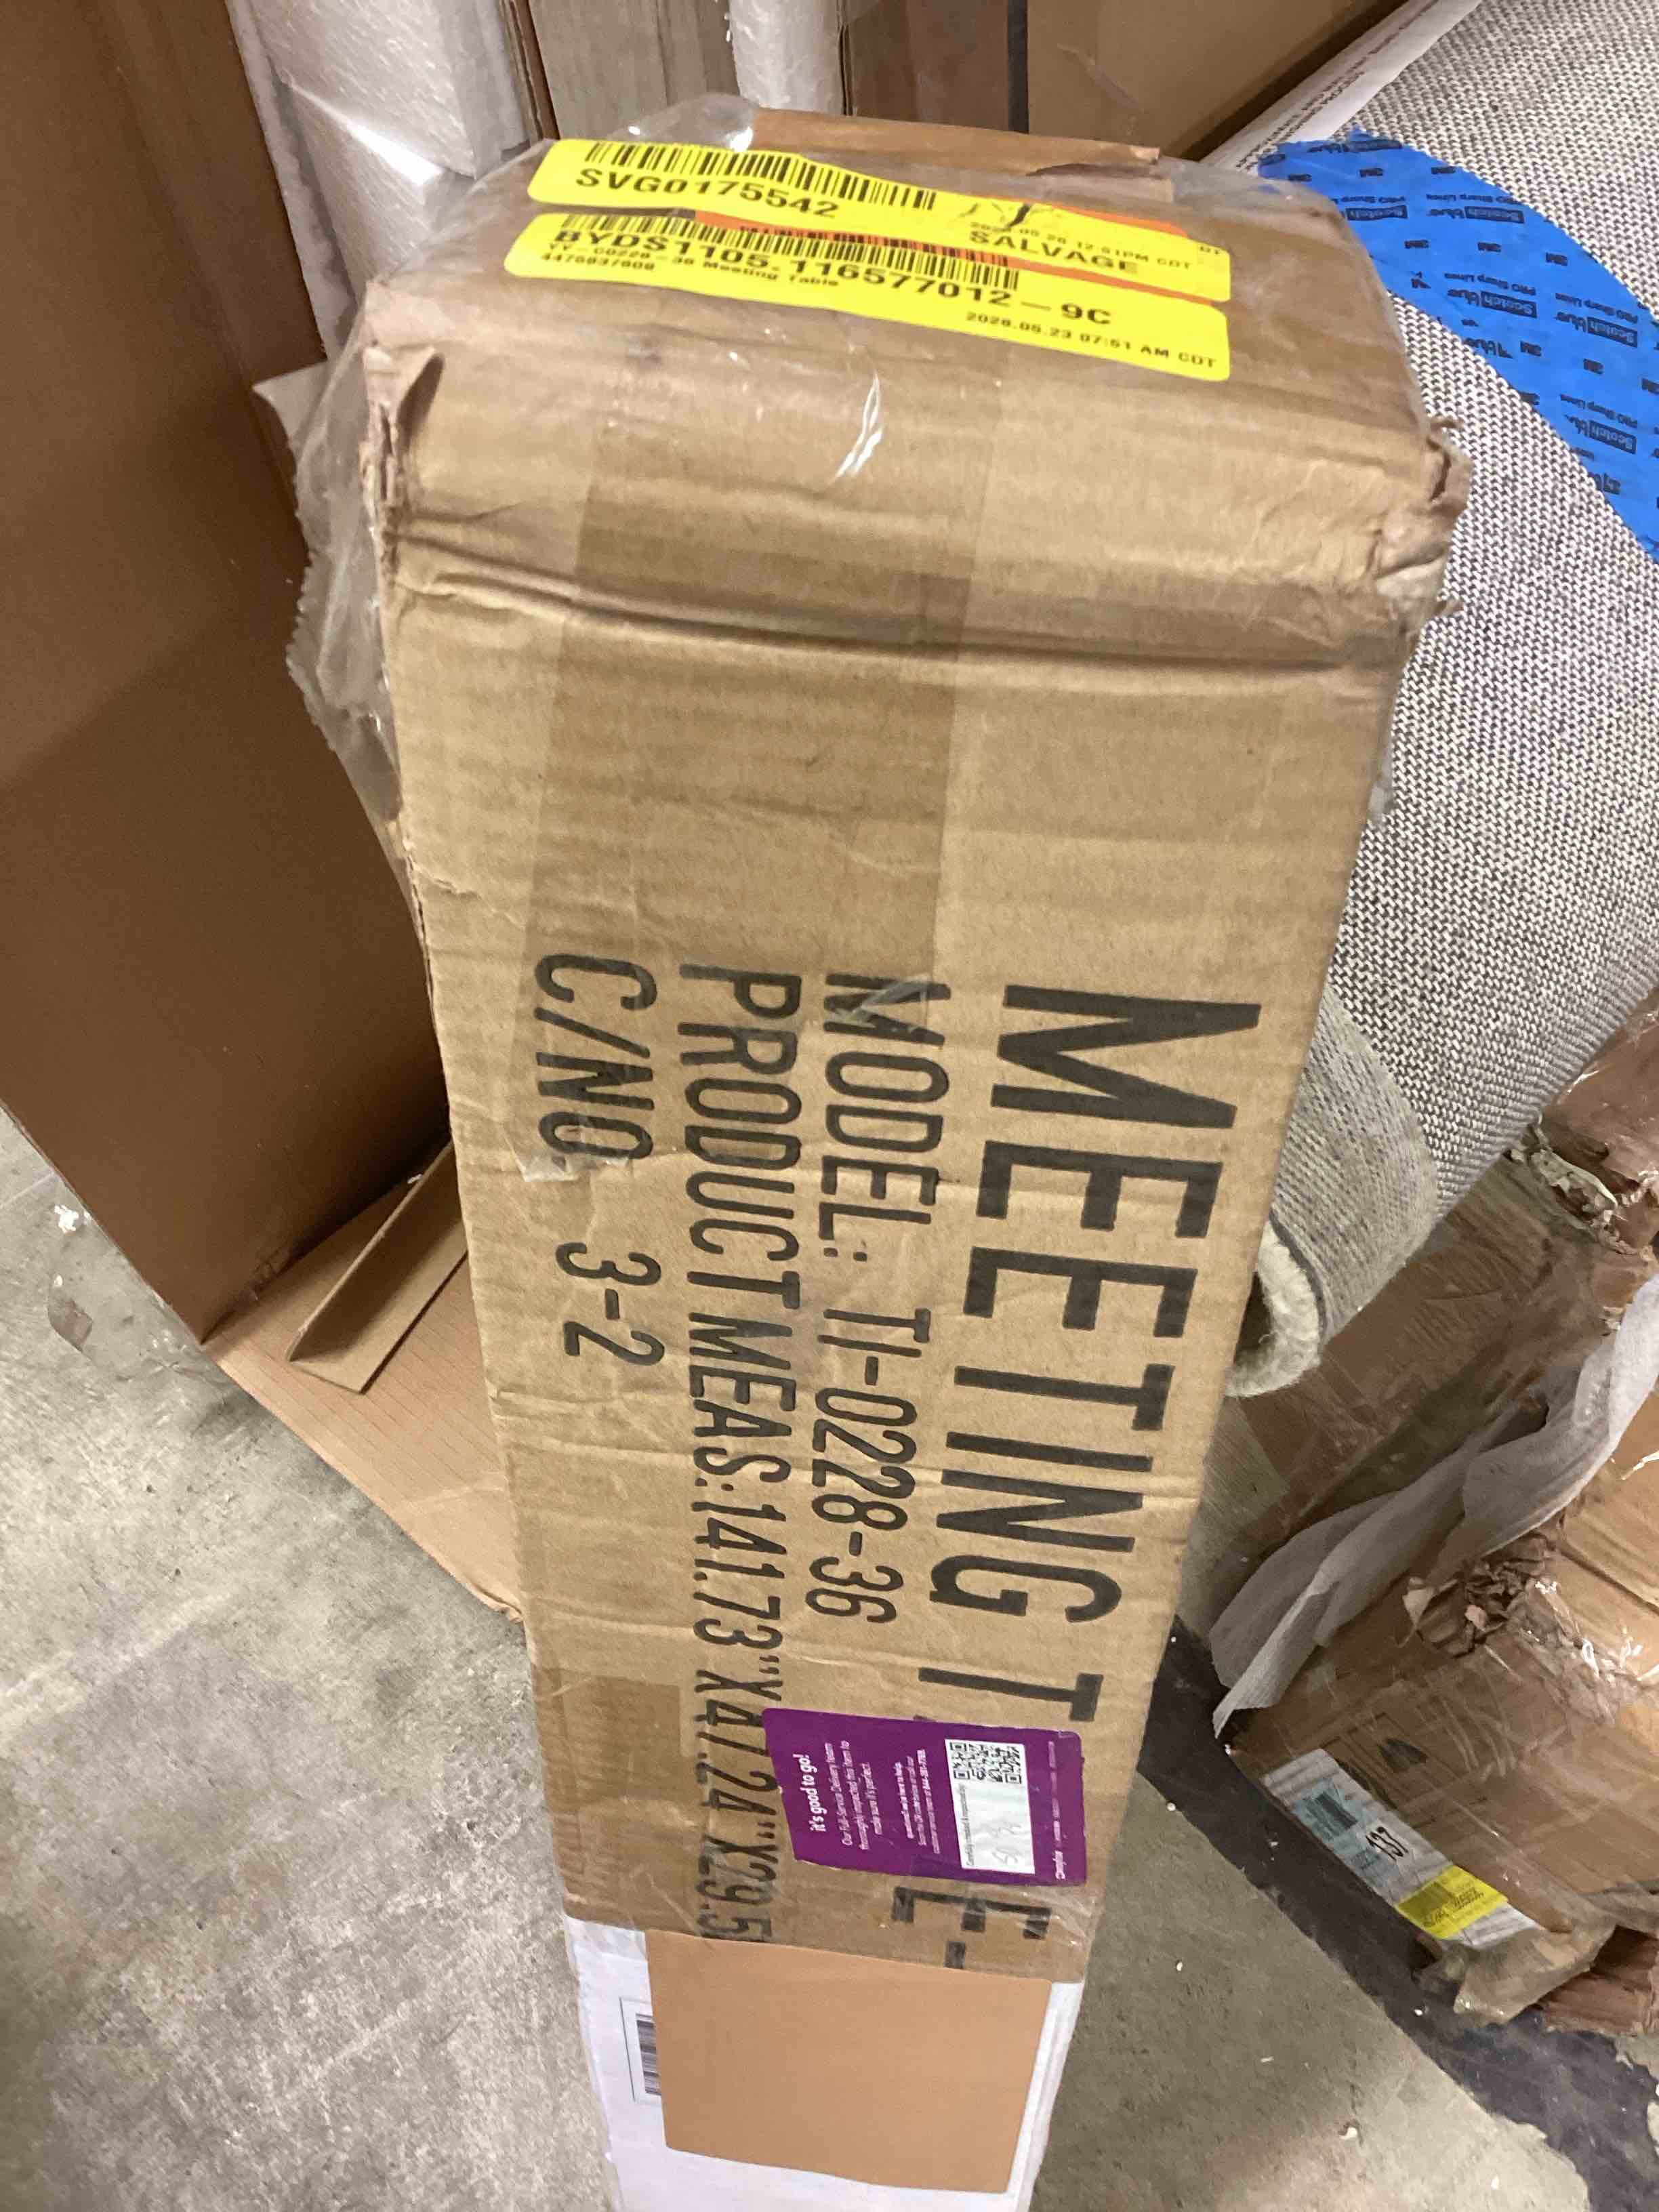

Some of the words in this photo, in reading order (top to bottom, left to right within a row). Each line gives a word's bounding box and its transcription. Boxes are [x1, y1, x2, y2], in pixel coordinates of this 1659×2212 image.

[575, 168, 840, 218] SVG0175542
[969, 230, 1138, 274] SALVAGE
[1141, 346, 1170, 359] AM
[533, 954, 657, 1160] C/NO
[678, 963, 802, 1309] PRODUCT
[819, 973, 951, 1262] MODEL:
[555, 1242, 665, 1366] 3-2
[929, 985, 1262, 1623] MEETING
[805, 1308, 931, 1623] TI-0228-36
[792, 1754, 817, 1773] go!
[800, 1787, 827, 1814] good
[802, 1774, 815, 1786] to
